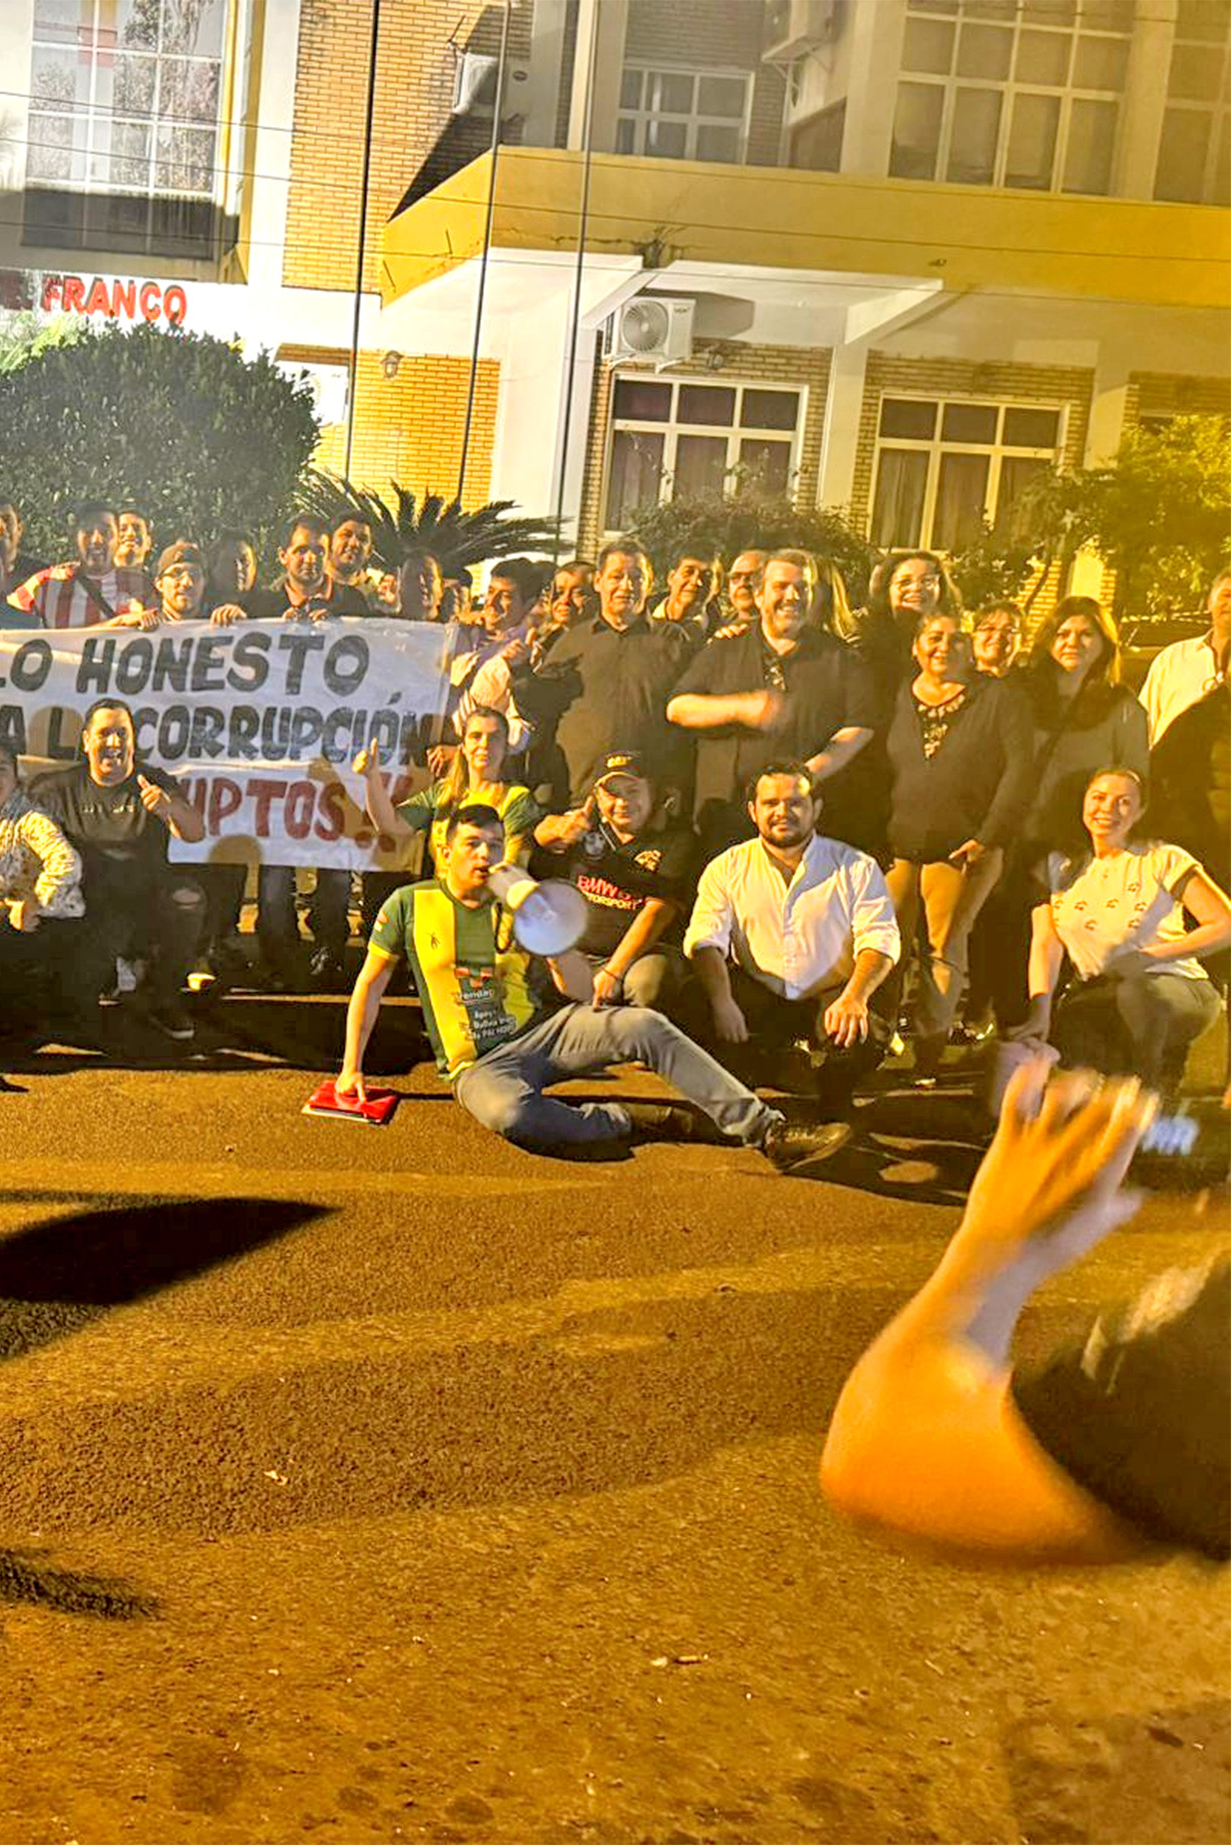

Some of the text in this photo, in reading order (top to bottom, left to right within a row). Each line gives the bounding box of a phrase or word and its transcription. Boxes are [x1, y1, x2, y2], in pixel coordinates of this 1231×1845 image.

[42, 272, 188, 325] FRANCO
[76, 631, 370, 697] HONESTO
[134, 691, 437, 766] CORRUPCIÓN
